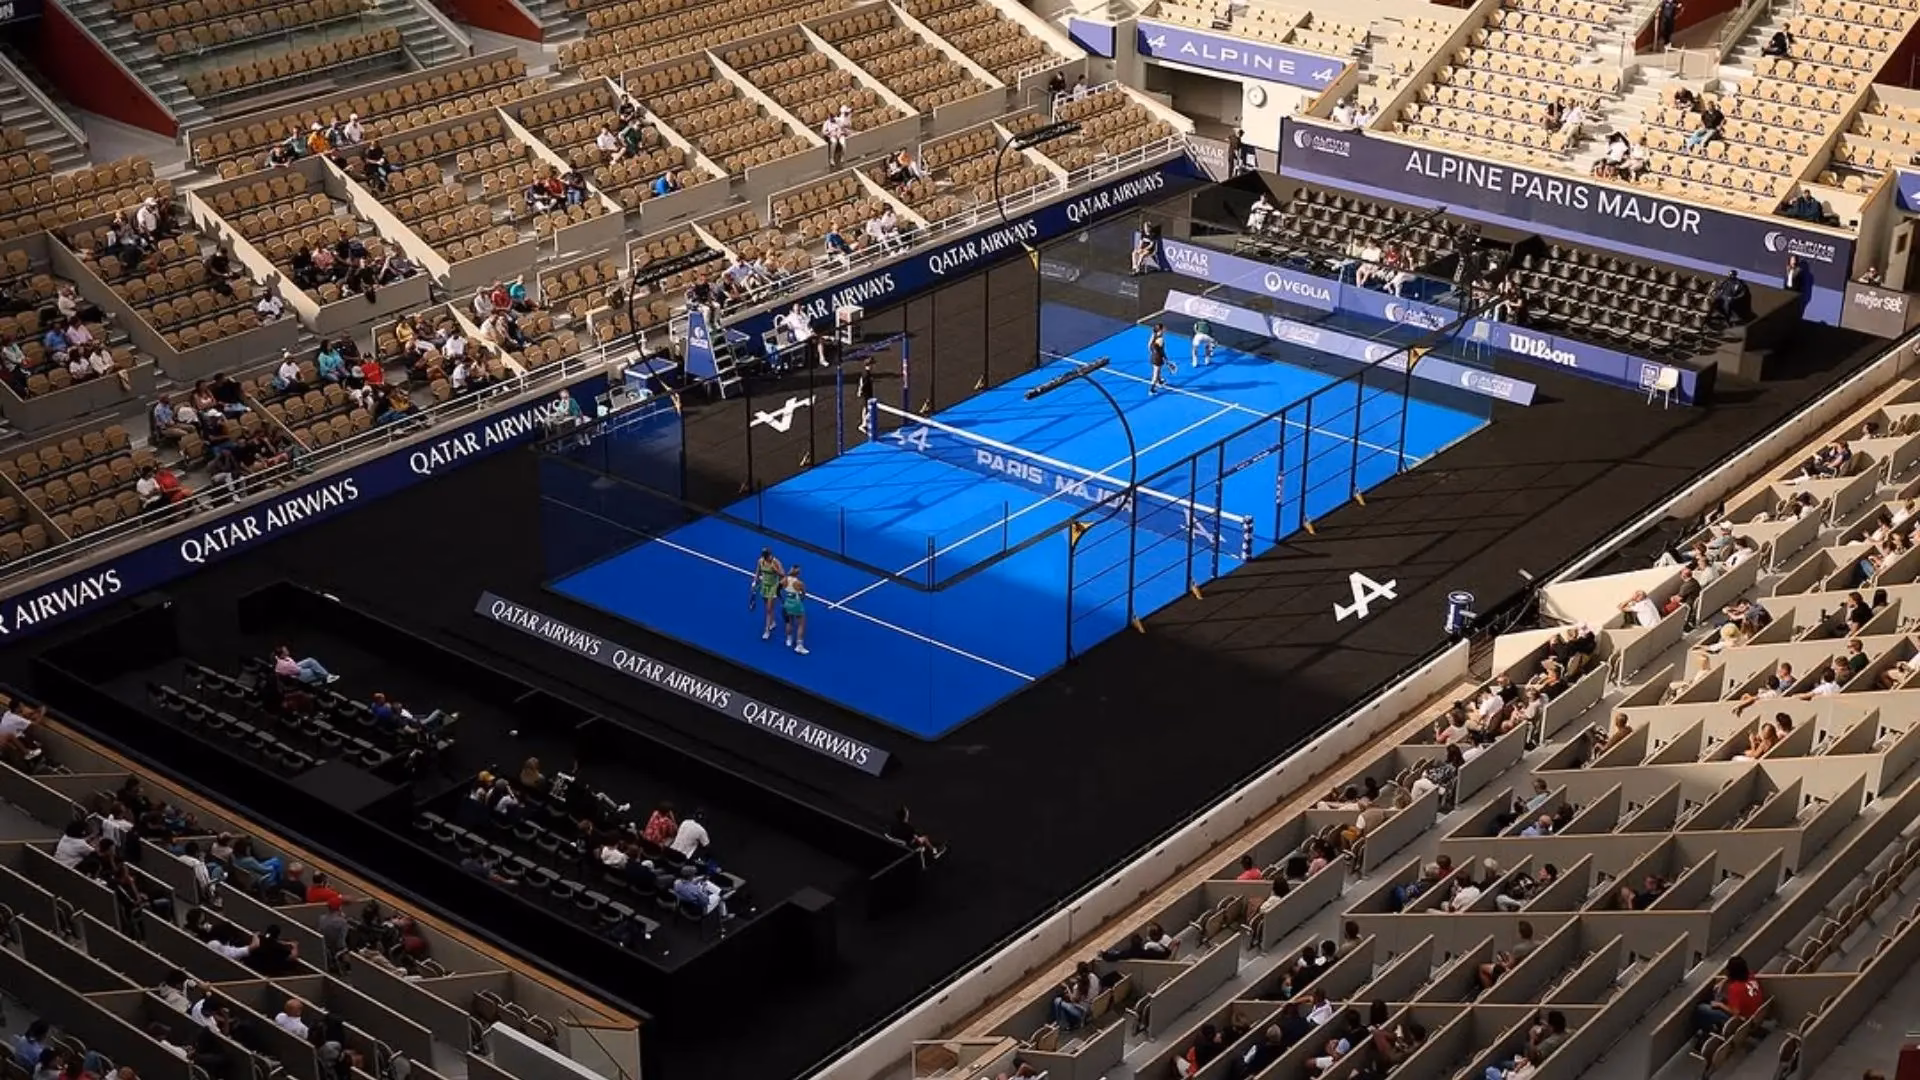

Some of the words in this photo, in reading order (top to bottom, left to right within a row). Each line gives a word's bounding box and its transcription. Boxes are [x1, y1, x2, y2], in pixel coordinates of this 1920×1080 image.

[1180, 41, 1295, 76] ALPINE
[1067, 190, 1112, 222] QATAR
[1112, 172, 1164, 206] AIRWAYS
[1405, 151, 1503, 191] ALPINE
[1511, 173, 1588, 210] PARIS
[1598, 192, 1701, 235] MAJOR
[929, 241, 978, 275] QATAR
[980, 220, 1037, 255] AIRWAYS
[1165, 246, 1208, 267] QATAR
[832, 273, 895, 312] AIRWAYS
[1284, 280, 1331, 301] VEOLIA
[1509, 332, 1577, 367] Wilson
[410, 431, 481, 475] QATAR
[977, 449, 1042, 484] PARIS
[180, 515, 262, 563] QATAR
[267, 477, 358, 532] AIRWAYS
[15, 568, 122, 630] AIRWAYS
[491, 600, 540, 630] QATAR
[539, 620, 601, 656] AIRWAYS
[613, 650, 664, 681] QATAR
[663, 671, 731, 708] AIRWAYS
[743, 702, 797, 735] QATAR
[797, 725, 869, 766] AIRWAYS
